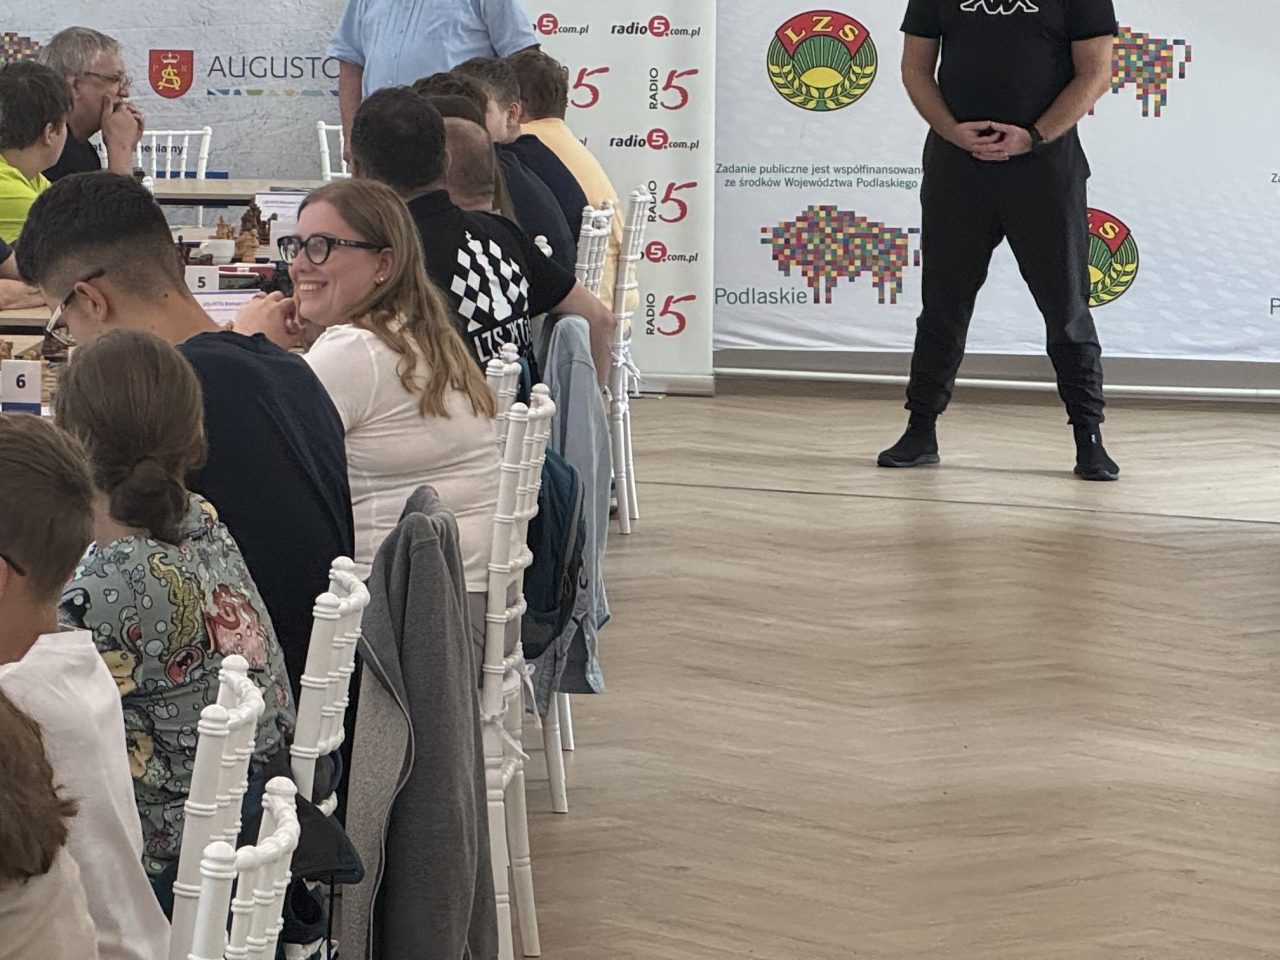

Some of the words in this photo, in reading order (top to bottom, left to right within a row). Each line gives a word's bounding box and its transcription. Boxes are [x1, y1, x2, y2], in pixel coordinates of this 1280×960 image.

[783, 16, 859, 44] LZS
[207, 55, 341, 79] AUGUSTO
[571, 67, 610, 108] 5
[649, 67, 659, 109] RADIO
[660, 69, 699, 110] 5
[715, 163, 756, 174] Zadanie
[759, 164, 808, 177] publiczne
[811, 165, 830, 176] jest
[724, 179, 736, 187] ze
[738, 177, 781, 187] środków
[784, 178, 852, 189] Województwa
[856, 178, 918, 190] Podlaskiego
[659, 182, 697, 223] 5
[197, 276, 206, 288] 5
[715, 287, 807, 305] Podlaskie
[646, 293, 655, 335] RADIO
[657, 294, 696, 336] 5
[15, 373, 26, 389] 6
